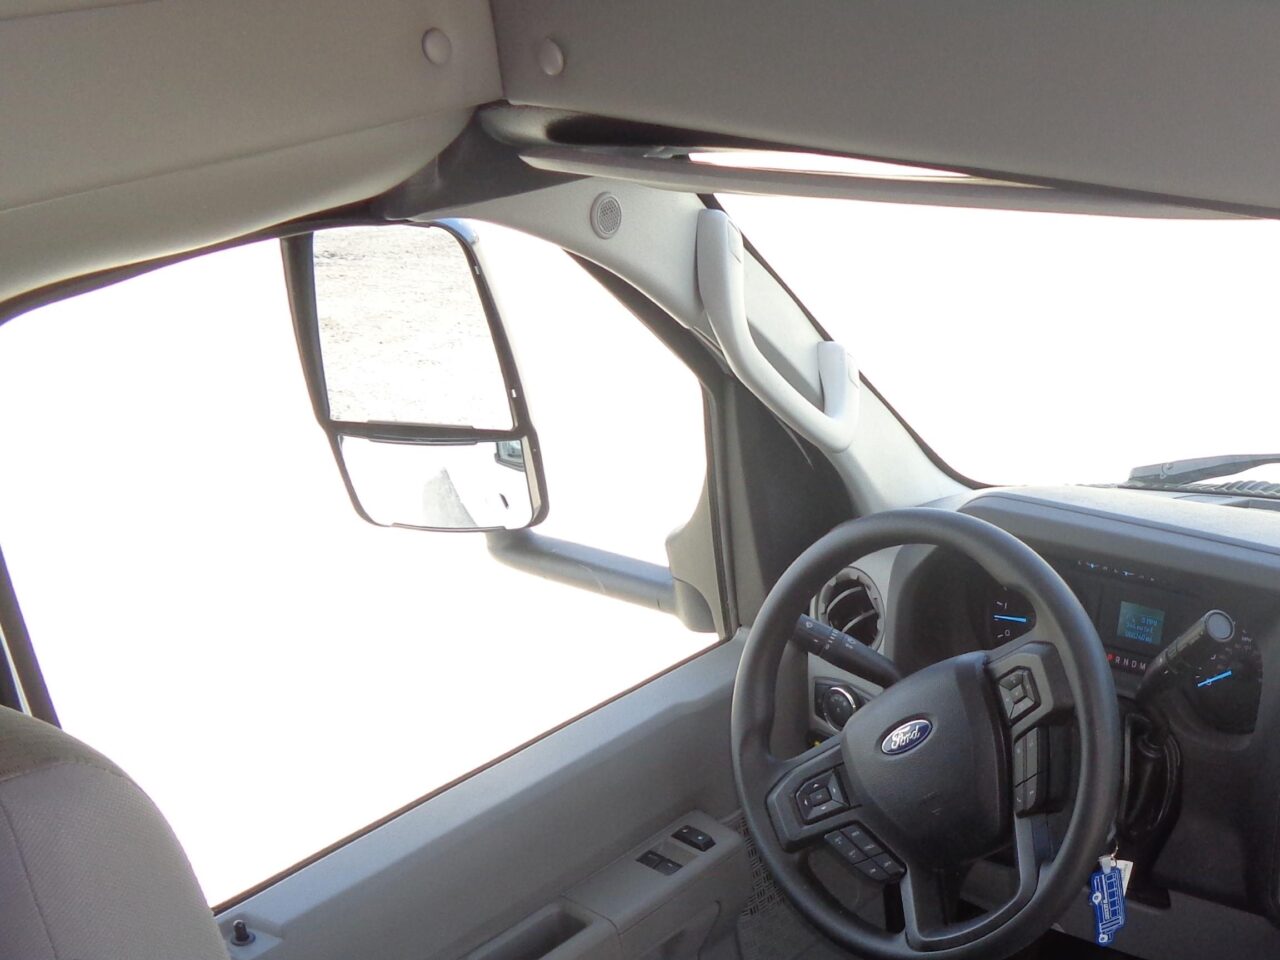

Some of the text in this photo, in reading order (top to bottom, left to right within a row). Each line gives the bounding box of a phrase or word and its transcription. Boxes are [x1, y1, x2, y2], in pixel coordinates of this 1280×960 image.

[1115, 656, 1120, 664] R
[1131, 660, 1137, 668] D
[890, 725, 921, 749] Ford
